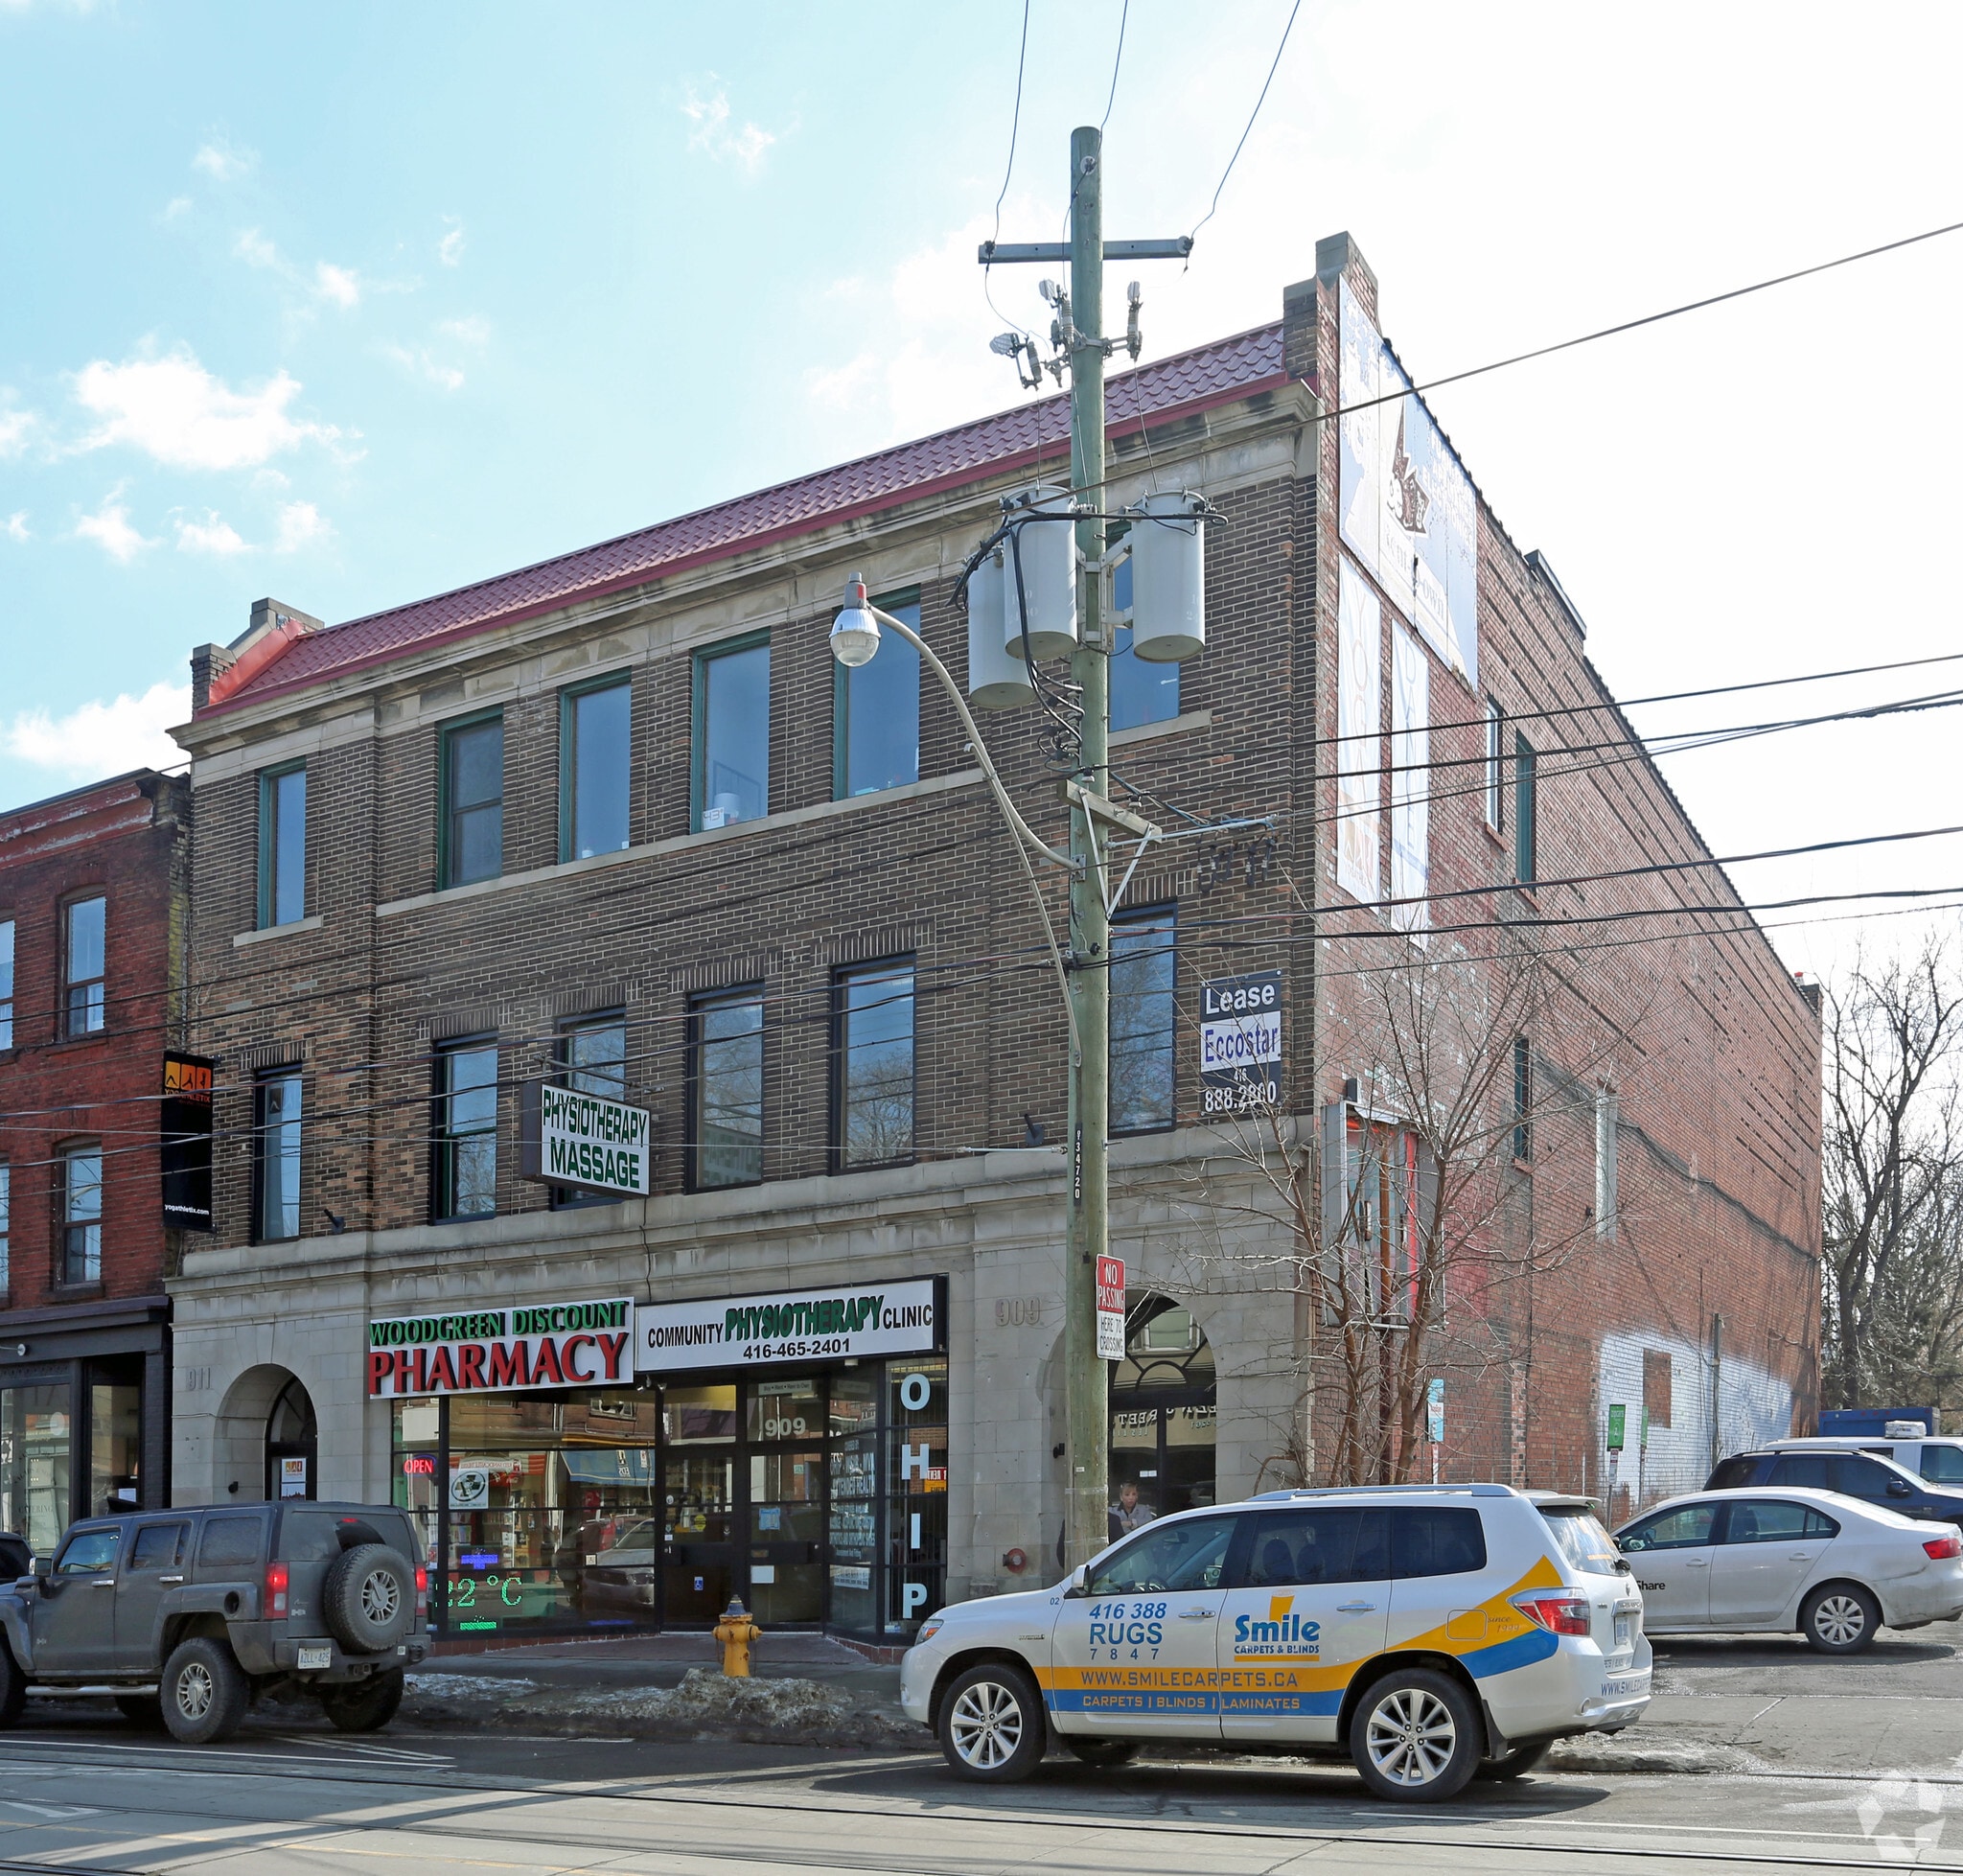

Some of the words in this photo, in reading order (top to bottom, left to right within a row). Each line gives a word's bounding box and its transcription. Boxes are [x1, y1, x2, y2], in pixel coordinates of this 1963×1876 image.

[1352, 583, 1369, 803] YOGA
[1206, 984, 1275, 1015] Lease
[1205, 1026, 1279, 1063] Eccostar
[1234, 1068, 1247, 1082] 416
[543, 1089, 647, 1147] PHYSIOTHERAPY
[550, 1136, 639, 1189] MASSAGE
[165, 1204, 210, 1216] yogathletix.com
[1104, 1263, 1118, 1285] NO
[1097, 1286, 1124, 1311] PASSING
[648, 1323, 724, 1349] COMMUNITY
[725, 1295, 885, 1342] PHYSIOTHERAPY
[883, 1304, 933, 1330] CLINIC
[996, 1298, 1041, 1326] 909
[369, 1312, 505, 1346] WOODGREEN
[512, 1301, 629, 1335] DISCOUNT
[1100, 1316, 1115, 1332] HERE
[1115, 1319, 1122, 1334] TO
[743, 1338, 851, 1359] 416-465-2401
[1099, 1334, 1123, 1353] CROSSING
[368, 1332, 629, 1394] PHARMACY
[765, 1417, 806, 1437] 909
[404, 1459, 434, 1473] OPEN
[1050, 1597, 1060, 1606] 02
[1089, 1603, 1125, 1620] 416
[1130, 1602, 1166, 1620] 388
[1090, 1622, 1163, 1645] RUGS
[1235, 1614, 1321, 1643] Smile
[1234, 1645, 1274, 1655] CARPETS
[1278, 1645, 1284, 1655] &
[1287, 1645, 1320, 1655] BLINDS
[1081, 1671, 1298, 1687] WWW.SMILECARPETS.CA
[1082, 1696, 1143, 1707] CARPETS
[1156, 1696, 1206, 1708] BLINDS
[1221, 1698, 1301, 1709] LAMINATES
